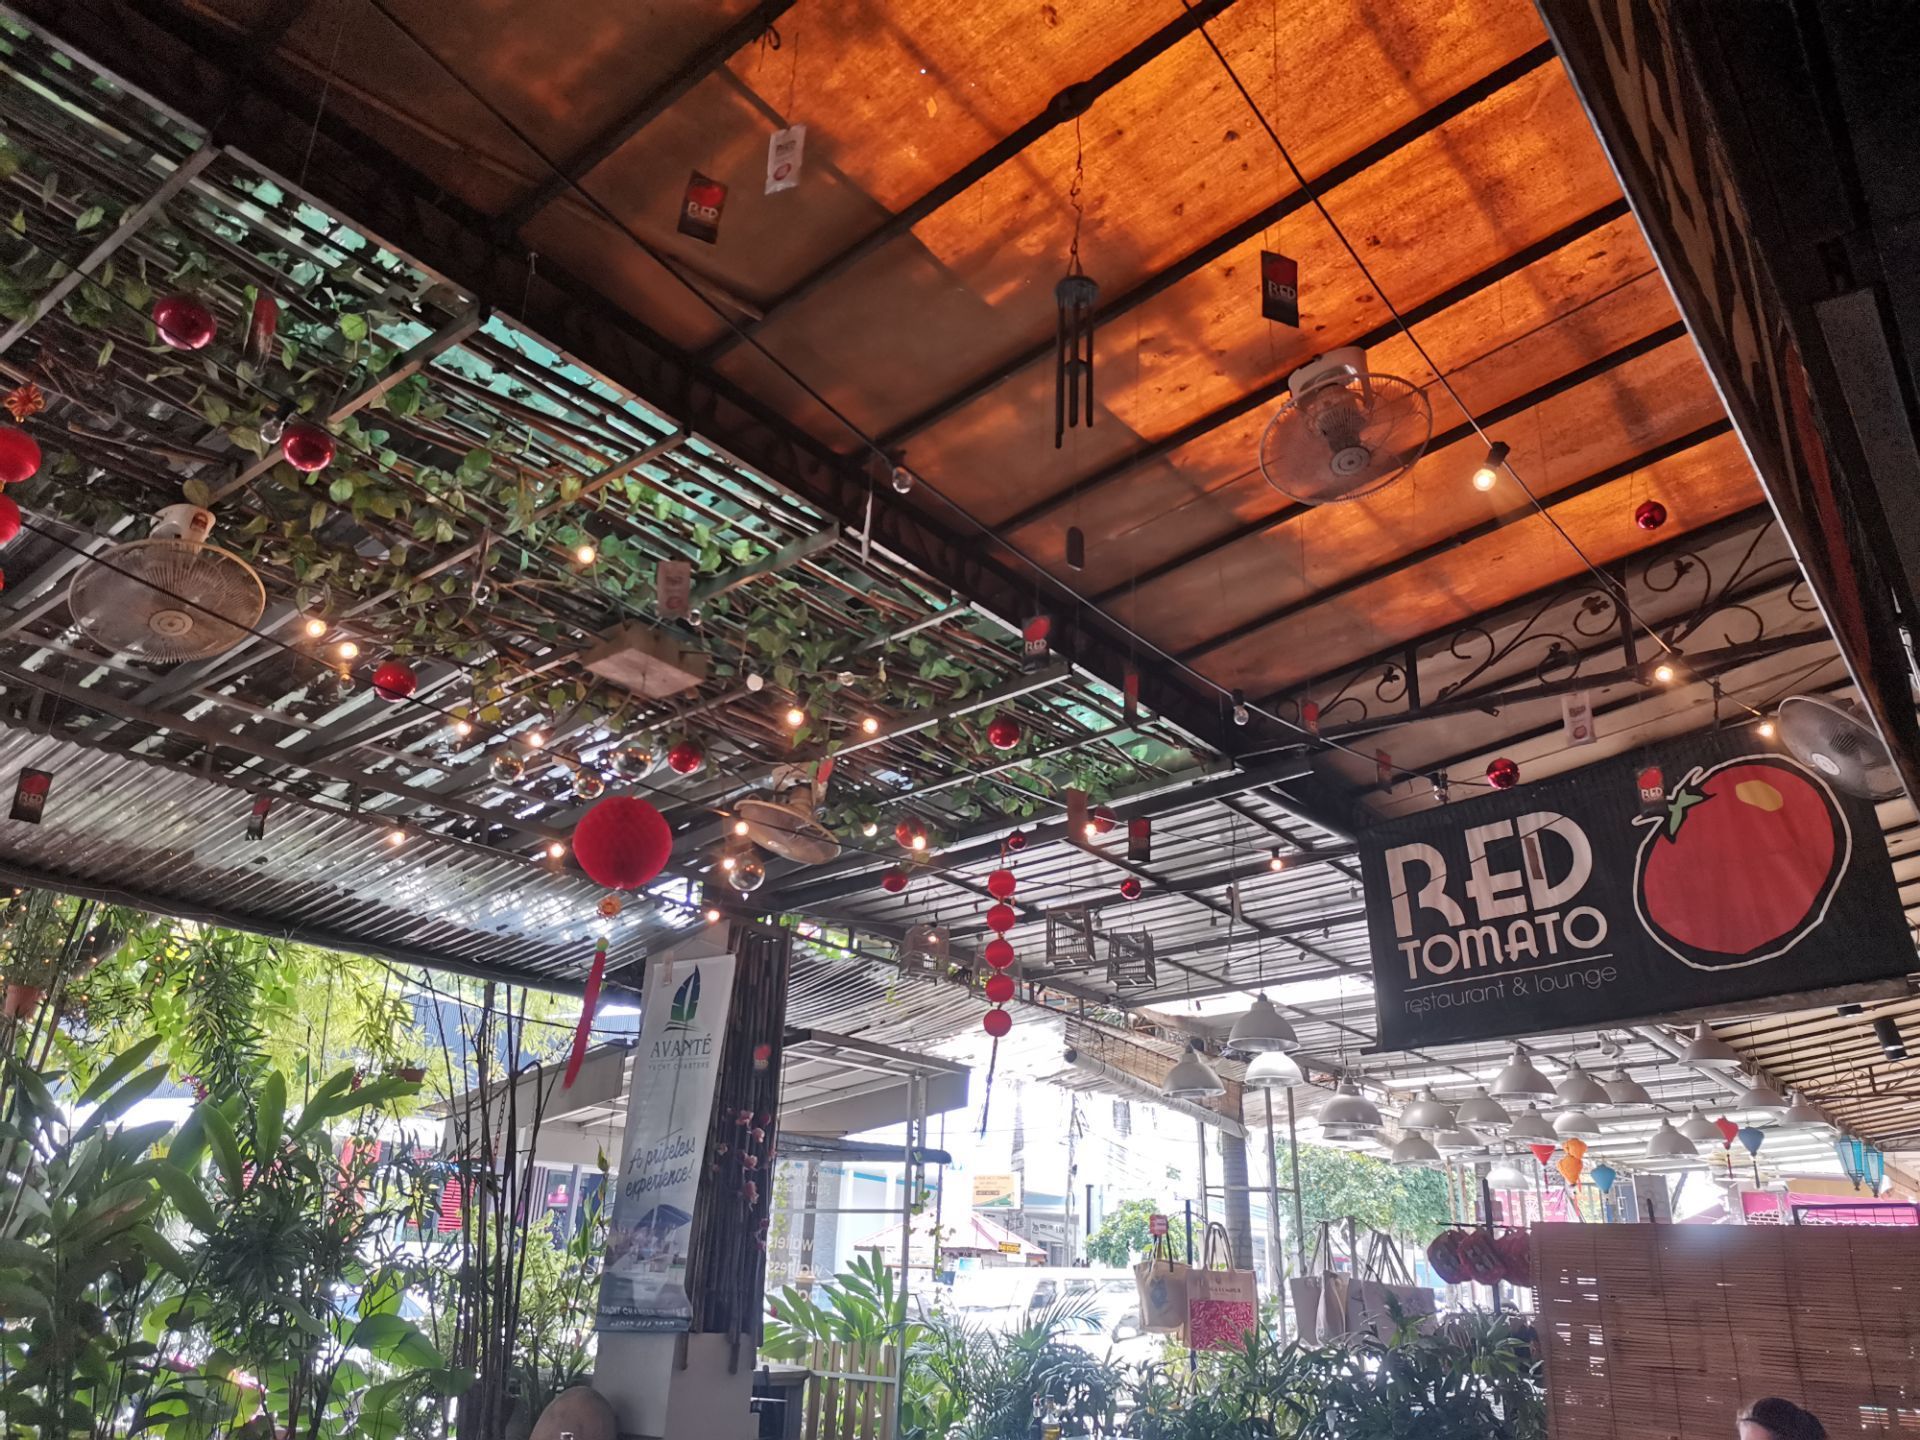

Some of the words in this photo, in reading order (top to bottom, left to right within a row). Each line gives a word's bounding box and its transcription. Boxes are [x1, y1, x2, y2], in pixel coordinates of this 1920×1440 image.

[1268, 280, 1296, 299] RED
[1641, 786, 1664, 802] RED
[1385, 811, 1592, 938] RED
[1398, 906, 1608, 979] TOMATO
[1403, 983, 1505, 1014] restaurant
[1512, 976, 1530, 997] &
[1534, 966, 1617, 993] lounge
[650, 1033, 712, 1058] AVANTÉ
[643, 1135, 695, 1175] priceless
[625, 1158, 695, 1201] experience!
